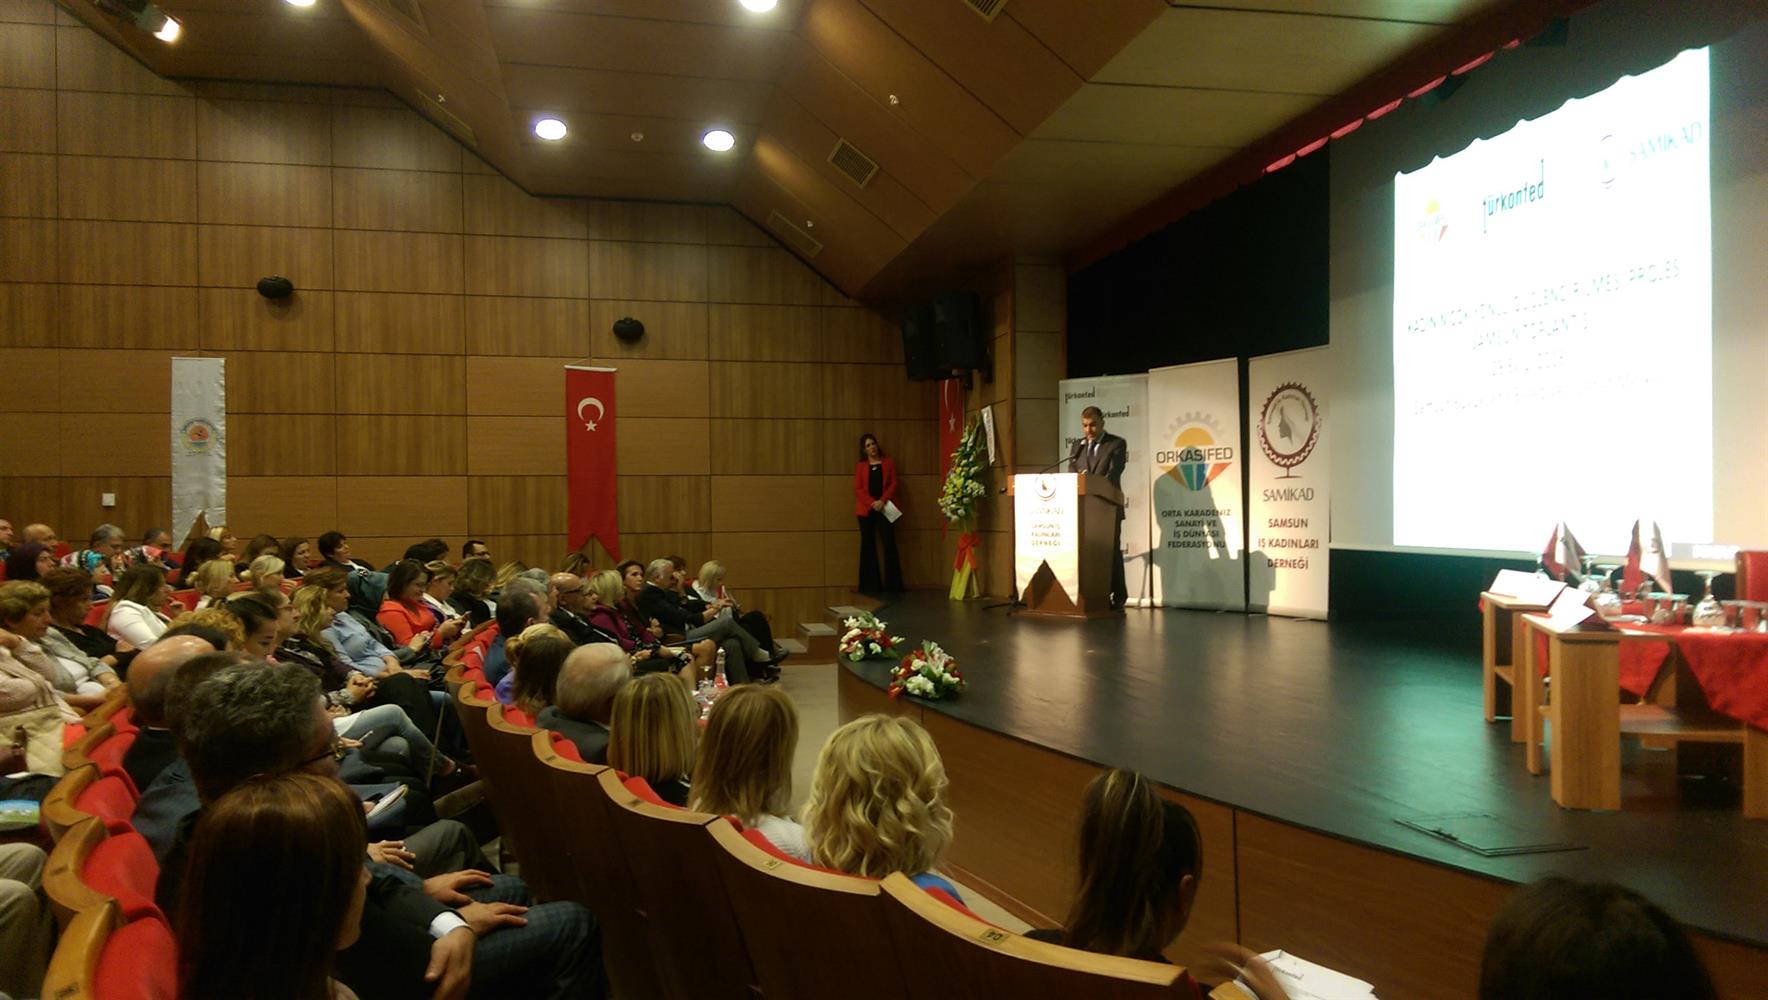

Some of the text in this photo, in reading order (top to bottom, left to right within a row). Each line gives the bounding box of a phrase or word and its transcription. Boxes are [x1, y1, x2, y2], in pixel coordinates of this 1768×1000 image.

[1161, 510, 1182, 518] ORTA
[1207, 519, 1217, 527] VE
[1268, 518, 1309, 529] SAMSUN
[1268, 538, 1319, 549] KADINLARI
